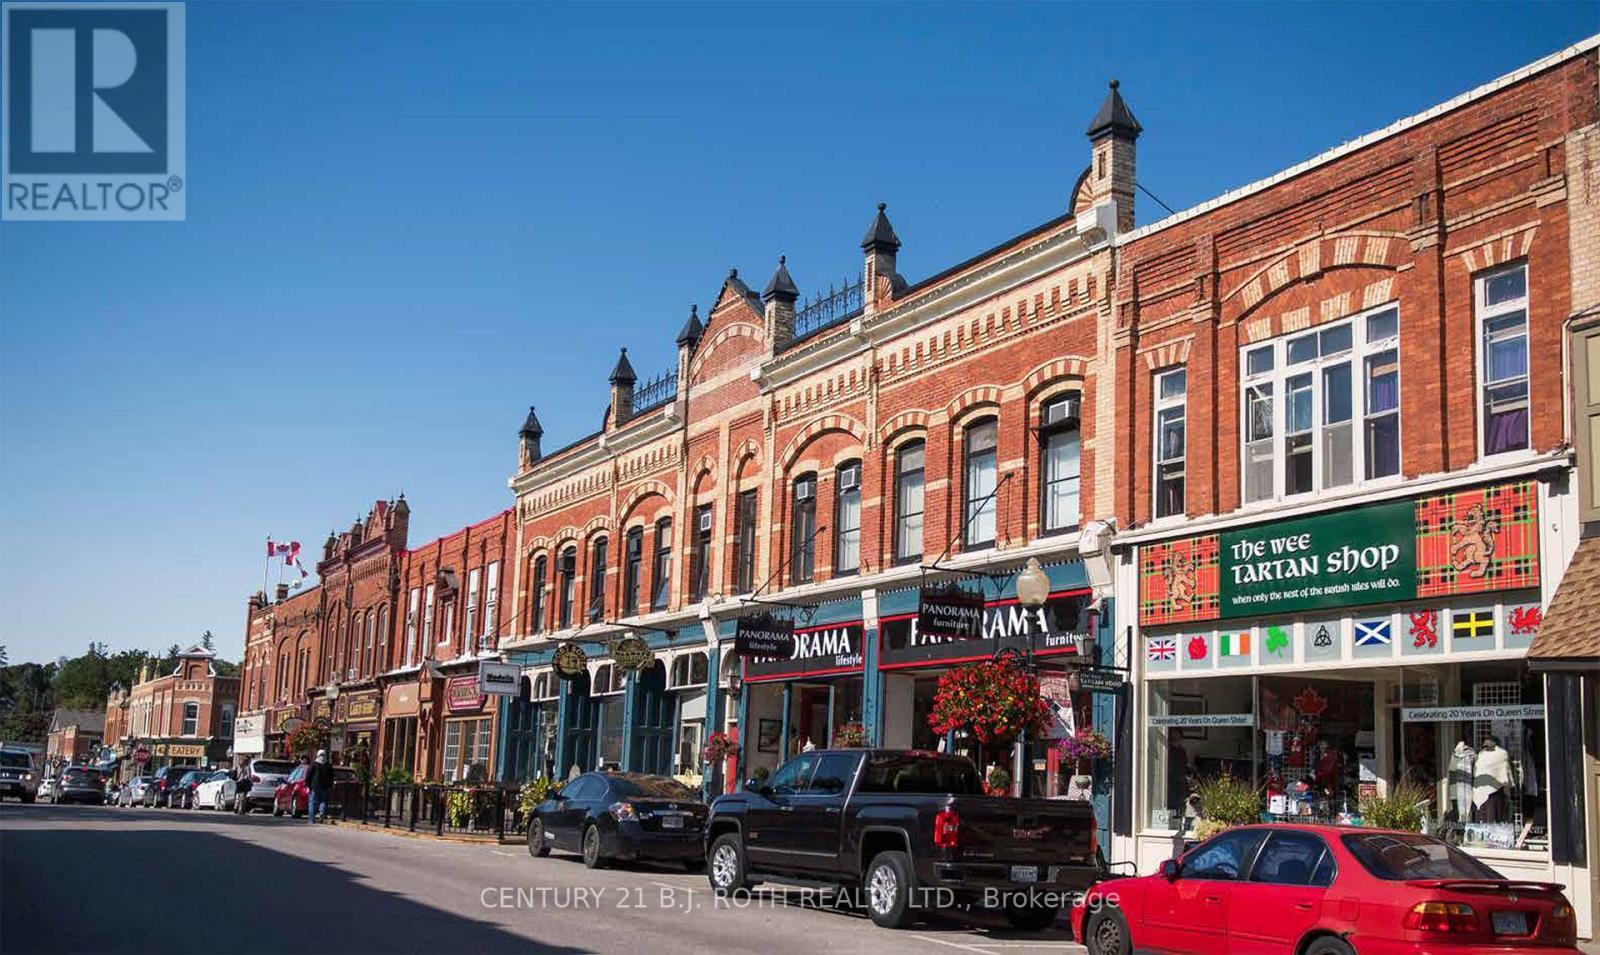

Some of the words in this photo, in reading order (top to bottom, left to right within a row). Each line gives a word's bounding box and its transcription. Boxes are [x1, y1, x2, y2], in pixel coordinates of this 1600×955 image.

[1231, 555, 1320, 585] TARTAN
[1253, 592, 1268, 603] only
[1270, 590, 1282, 600] the
[1300, 587, 1309, 598] of
[1310, 585, 1323, 595] the
[1370, 578, 1386, 590] will
[922, 603, 980, 619] PANORAMA
[933, 618, 970, 631] furniture
[739, 629, 789, 641] PANORAMA
[749, 641, 777, 651] lifestyle
[835, 653, 863, 667] lifestyle
[1409, 710, 1447, 720] Celebrating
[1449, 710, 1459, 718] 20
[1483, 708, 1494, 716] On
[1496, 708, 1522, 716] Queen
[172, 746, 200, 754] EATERY
